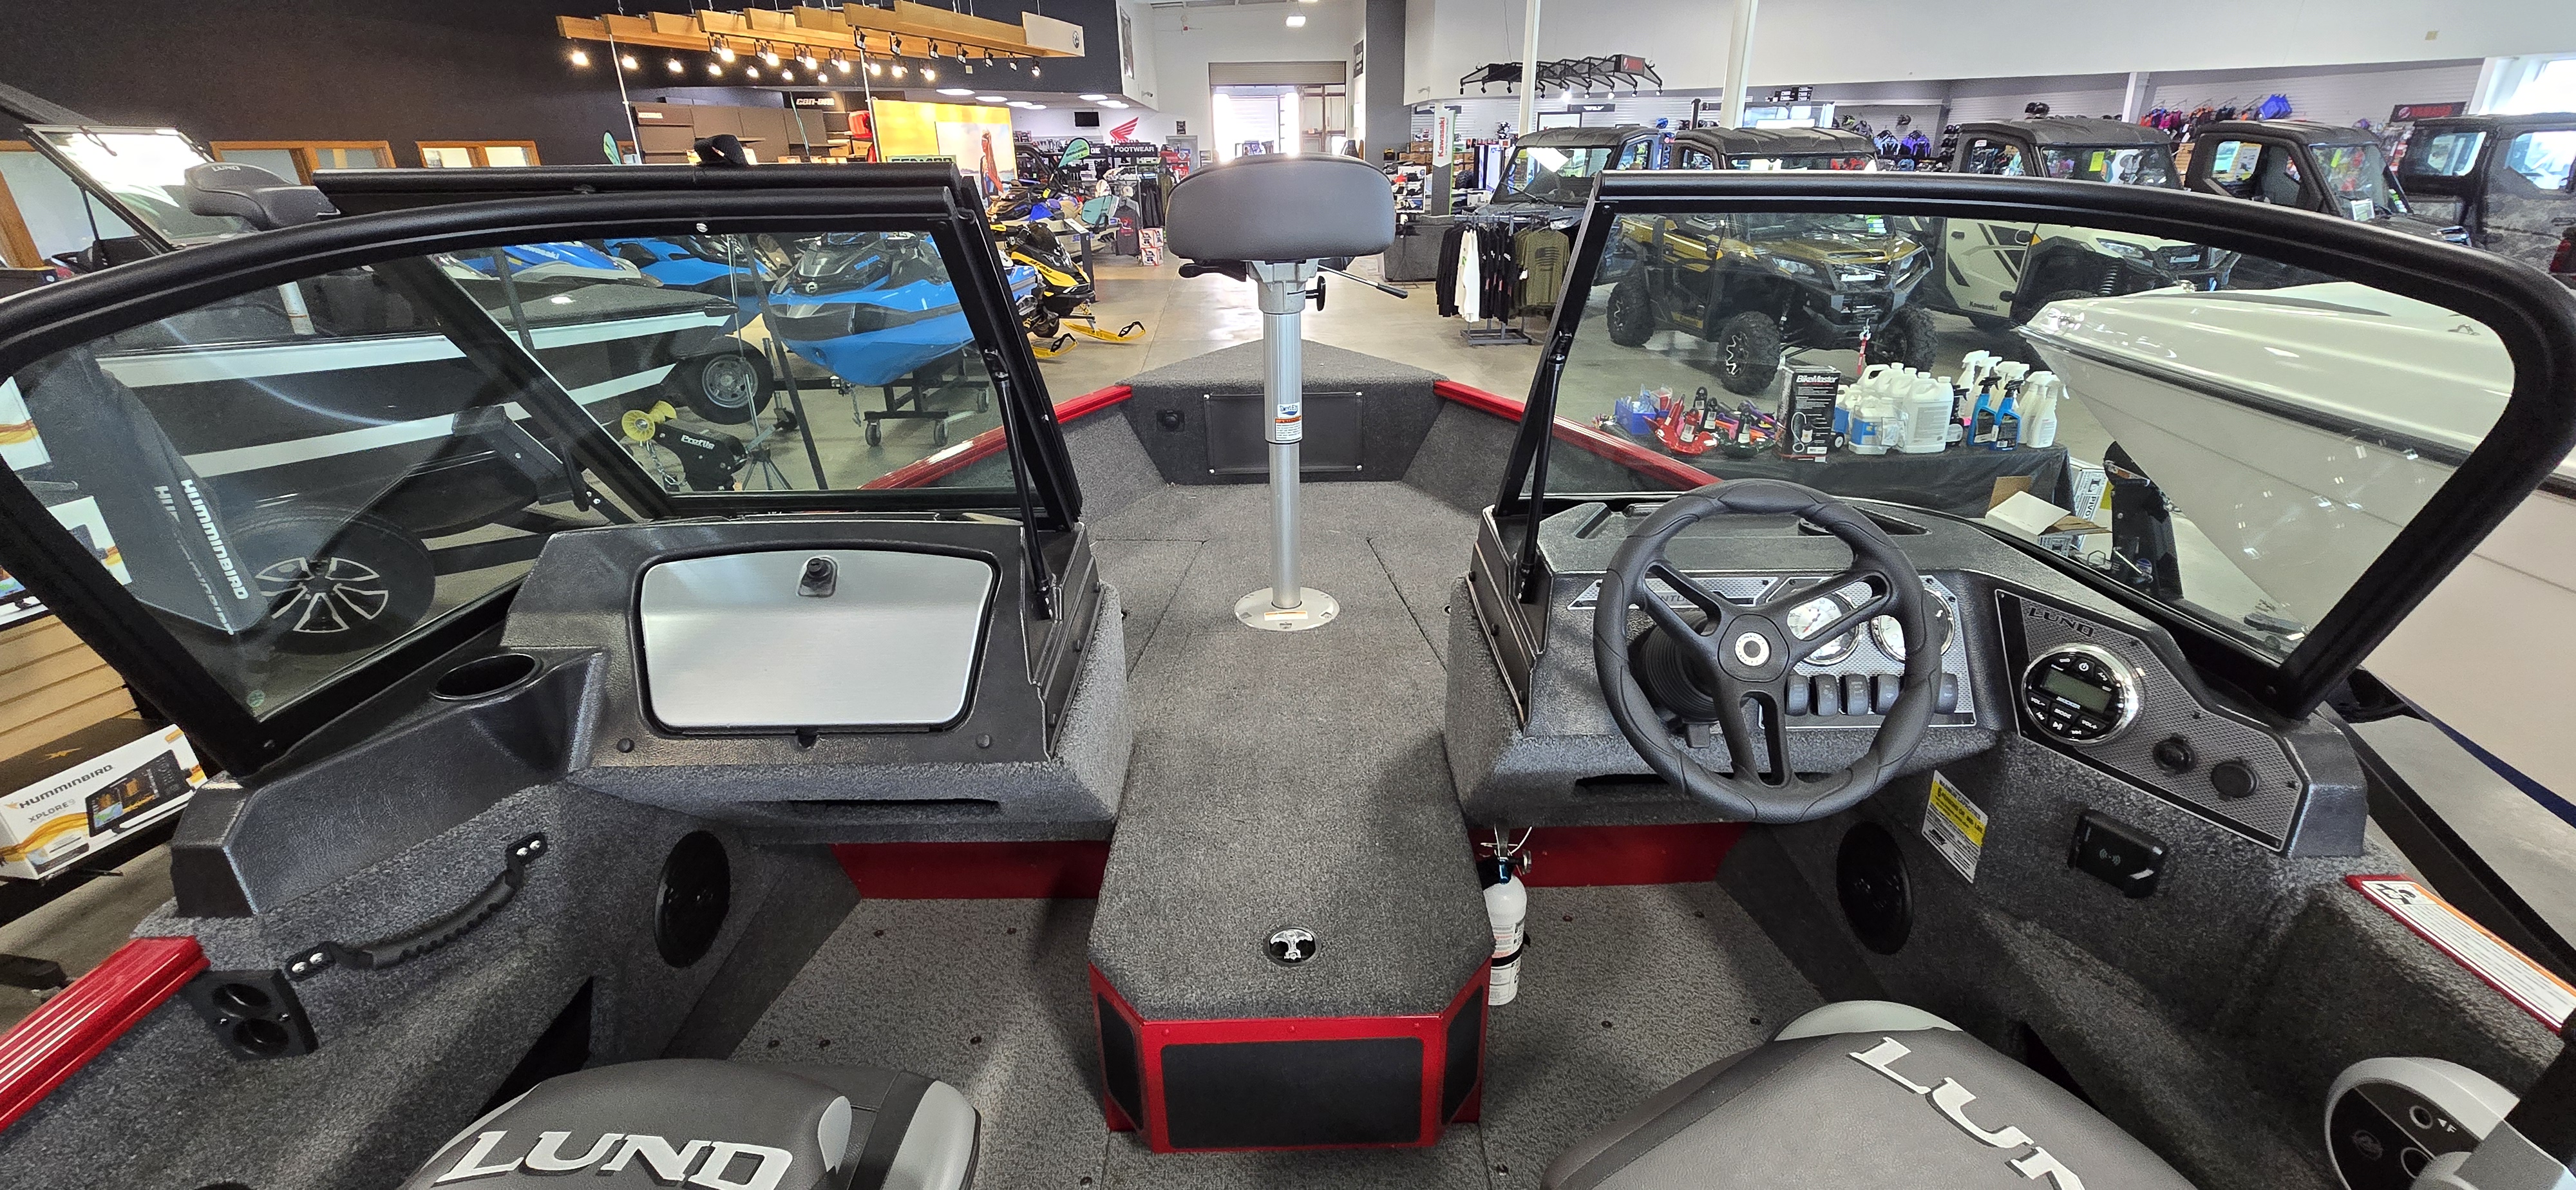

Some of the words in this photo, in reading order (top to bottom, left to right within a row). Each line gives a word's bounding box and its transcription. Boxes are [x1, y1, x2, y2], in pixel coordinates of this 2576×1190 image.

[1969, 300, 1998, 311] Kawasaki
[1796, 375, 1839, 383] BikeMaster
[2084, 496, 2097, 520] PIVO
[181, 479, 249, 600] HUMMINBIRD
[2028, 607, 2094, 638] LUND
[19, 764, 113, 809] HUMMINBIRD
[1847, 1036, 2085, 1190] LUN
[433, 1131, 793, 1190] LUND
